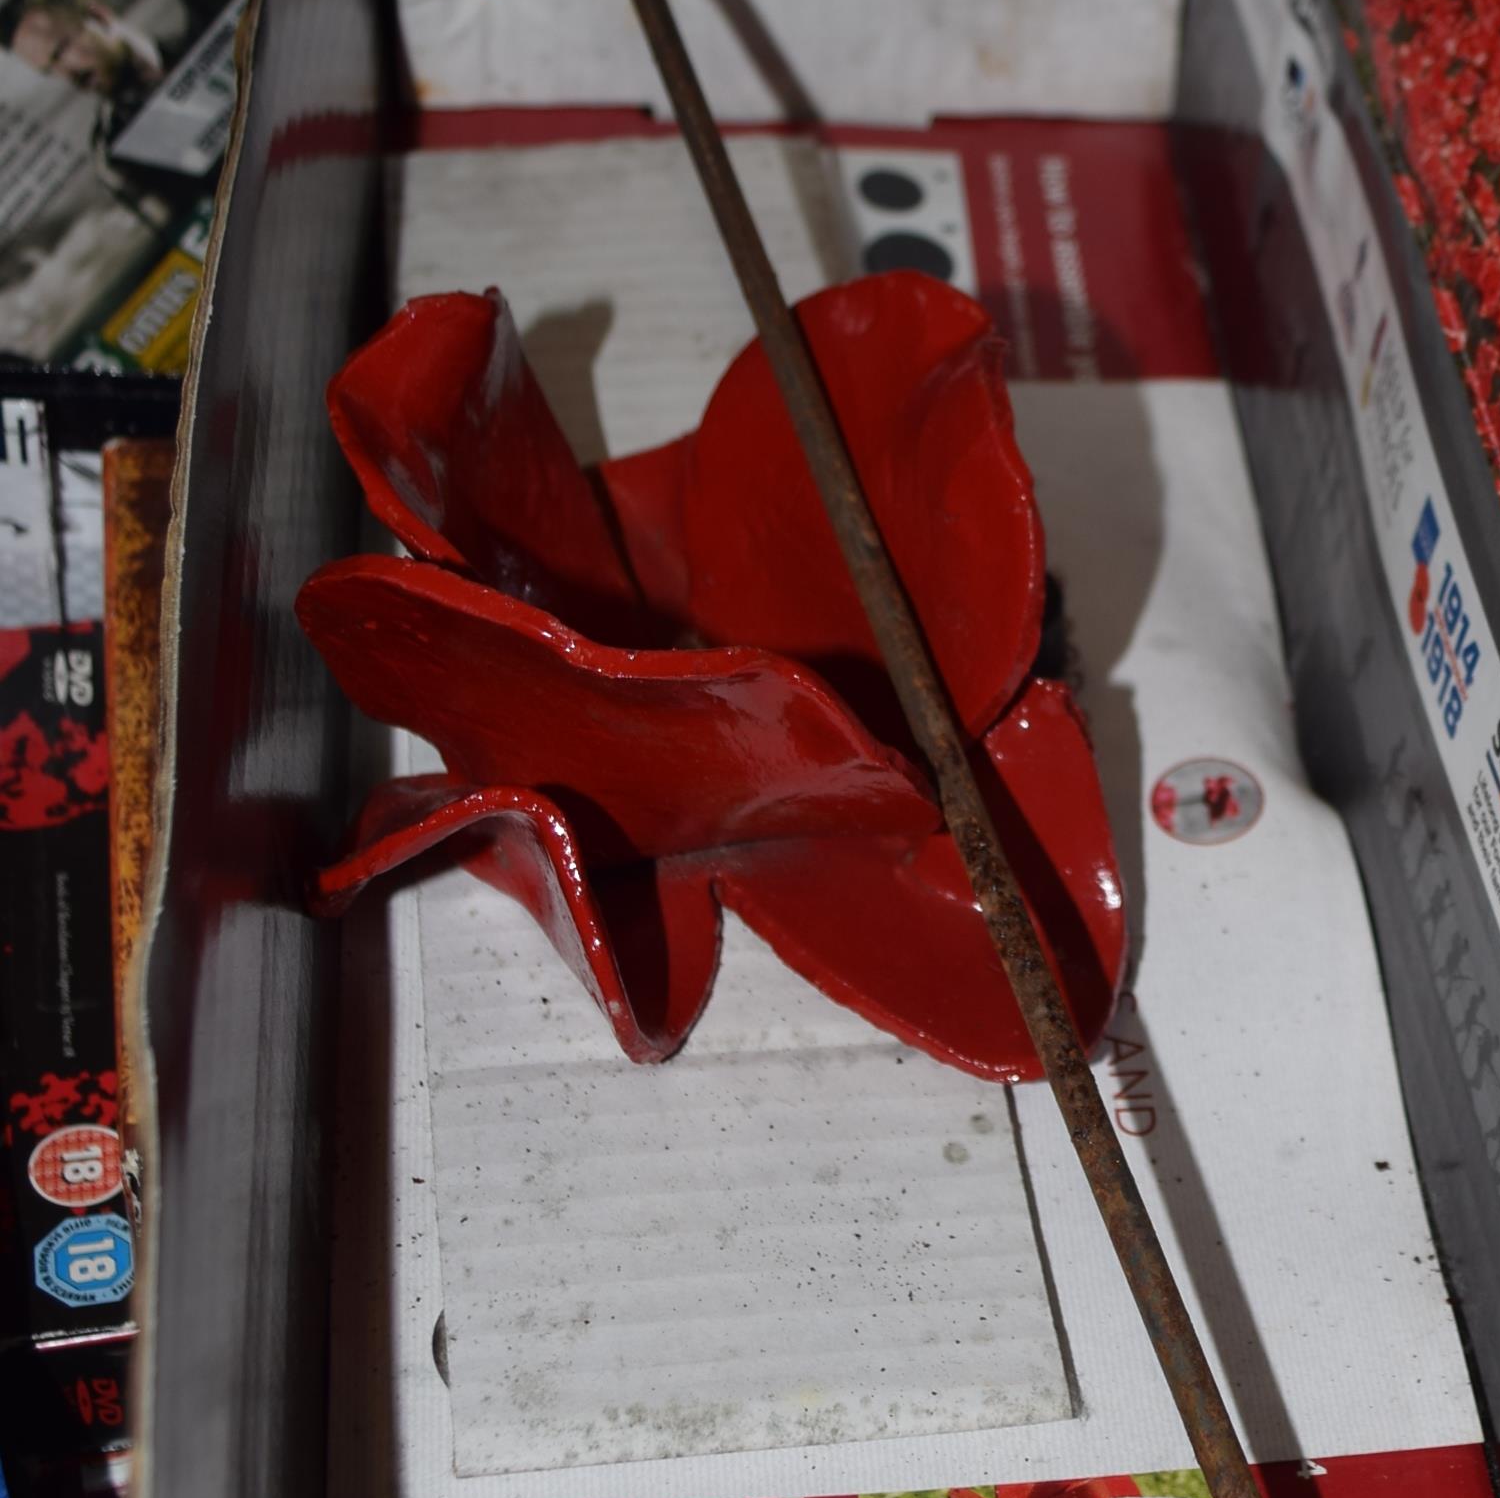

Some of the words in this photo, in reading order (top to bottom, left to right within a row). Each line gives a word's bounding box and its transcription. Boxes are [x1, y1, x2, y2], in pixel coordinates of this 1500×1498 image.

[1438, 561, 1480, 690] 1914
[68, 648, 95, 708] DVD
[1420, 611, 1463, 741] 1918
[1103, 1036, 1156, 1137] AND
[61, 1146, 103, 1186] 18
[67, 1237, 118, 1284] 18
[92, 1377, 124, 1426] DVD
[1296, 1460, 1328, 1481] 4
